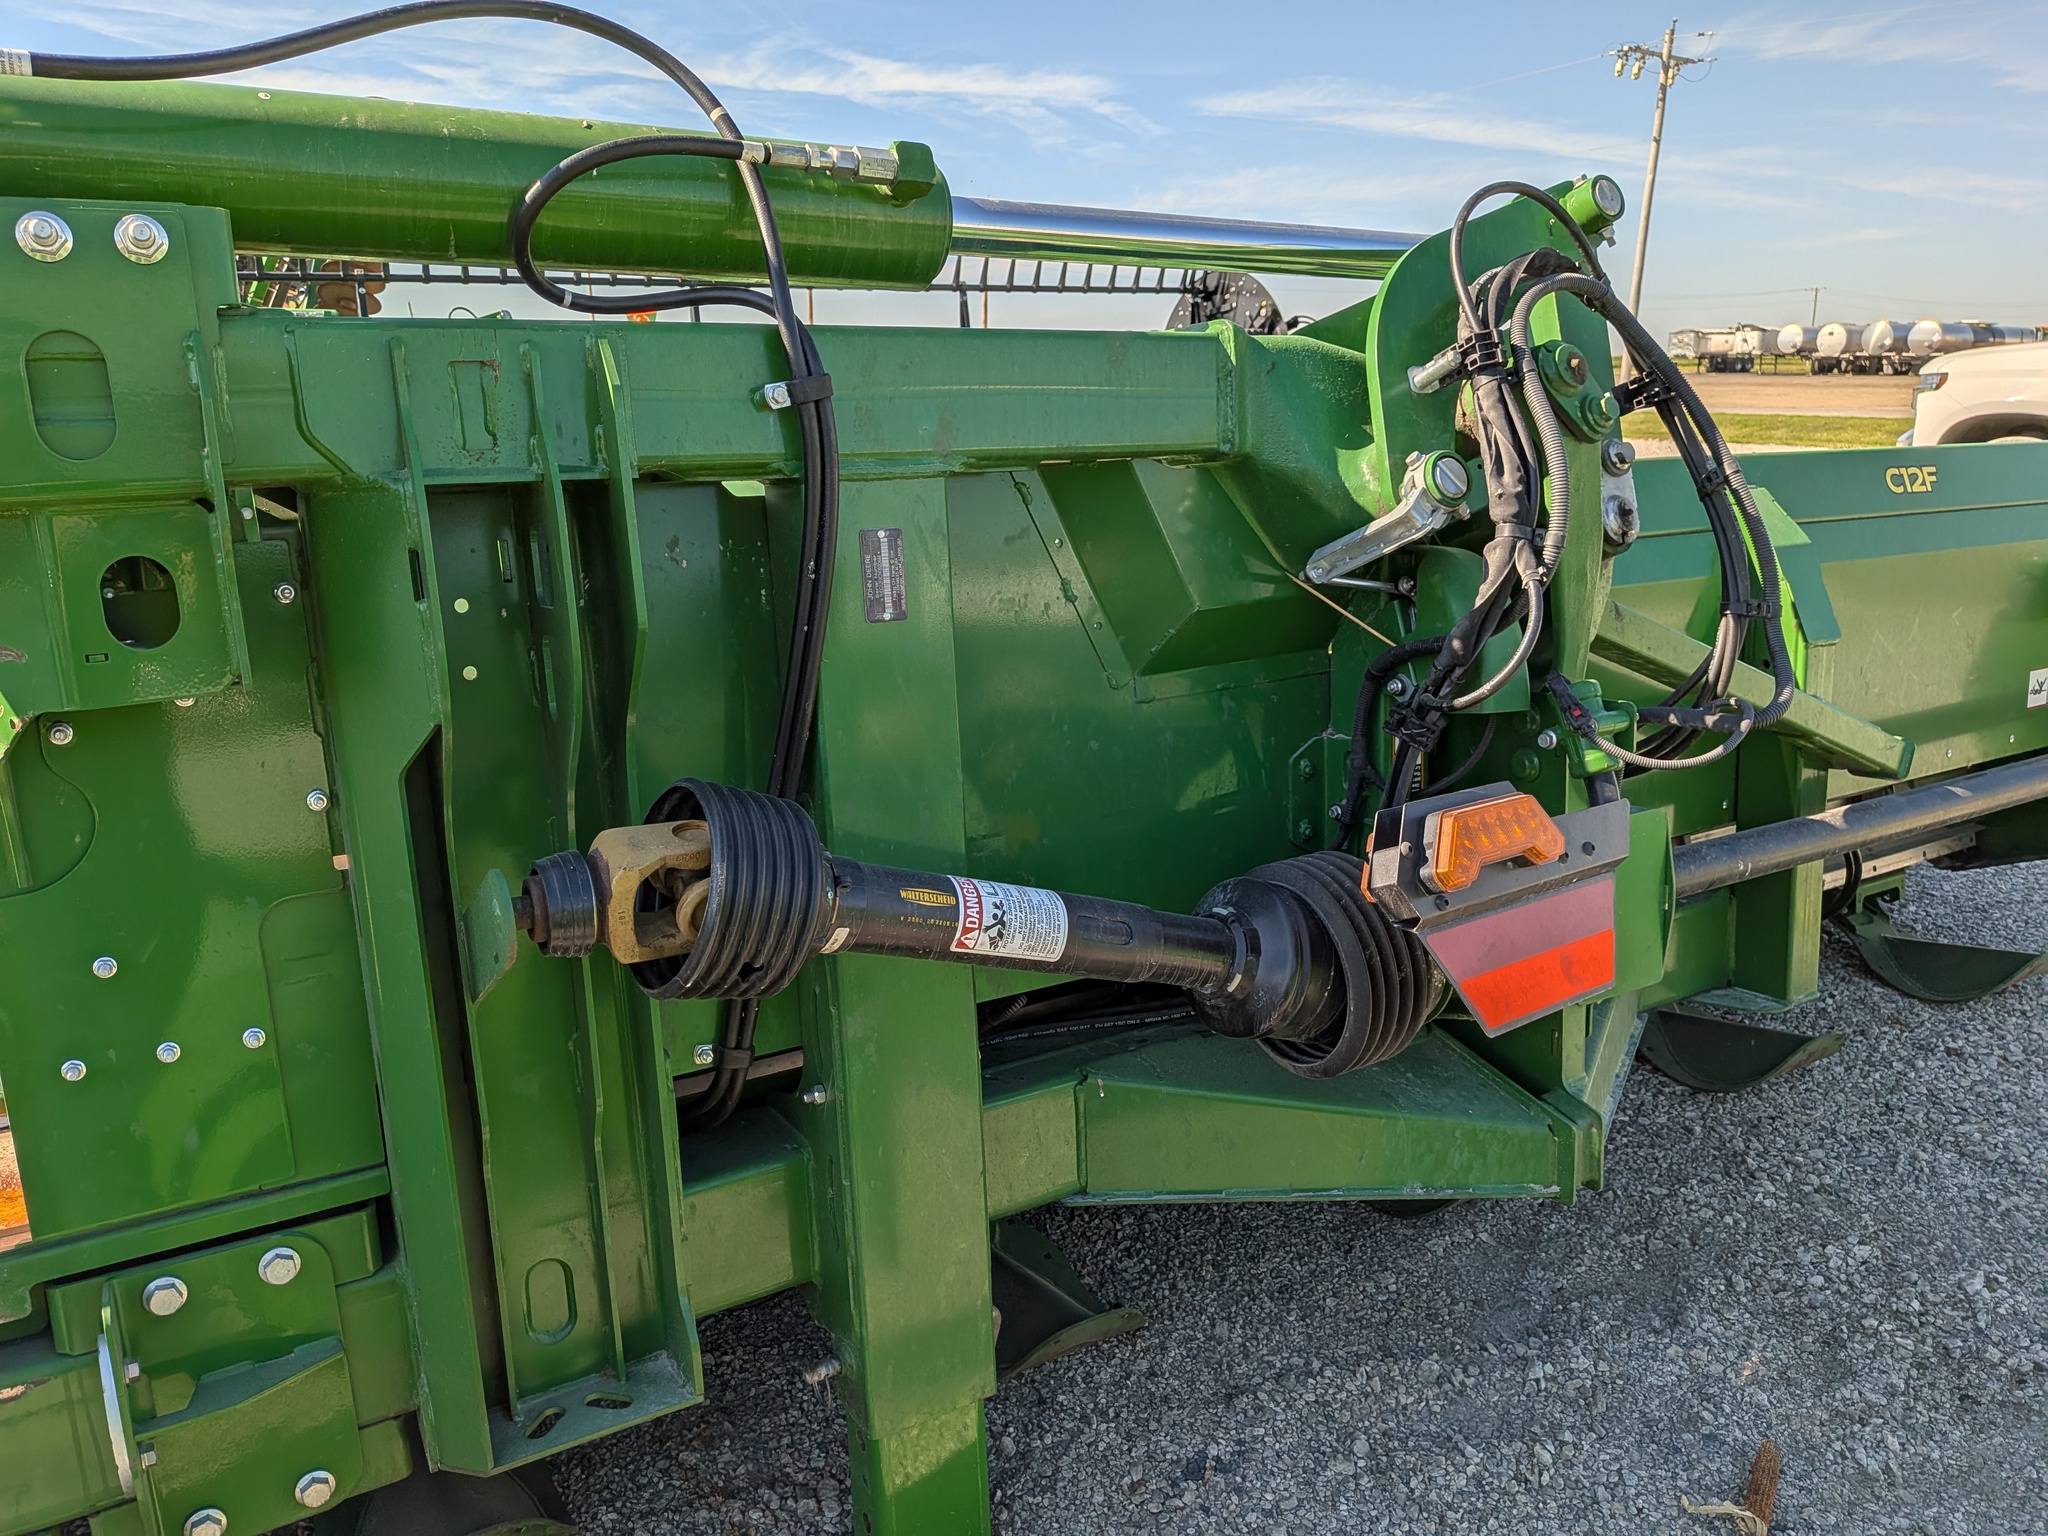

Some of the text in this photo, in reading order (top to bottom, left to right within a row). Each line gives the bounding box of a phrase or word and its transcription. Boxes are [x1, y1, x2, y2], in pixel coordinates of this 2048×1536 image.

[1885, 466, 1937, 494] C12F
[864, 554, 874, 600] JOHN DEERE
[899, 889, 957, 905] WALTERSCHEID
[1014, 894, 1023, 915] AWAY!
[1003, 917, 1013, 949] ROTATING
[1018, 942, 1024, 950] DO
[1050, 947, 1057, 955] DO
